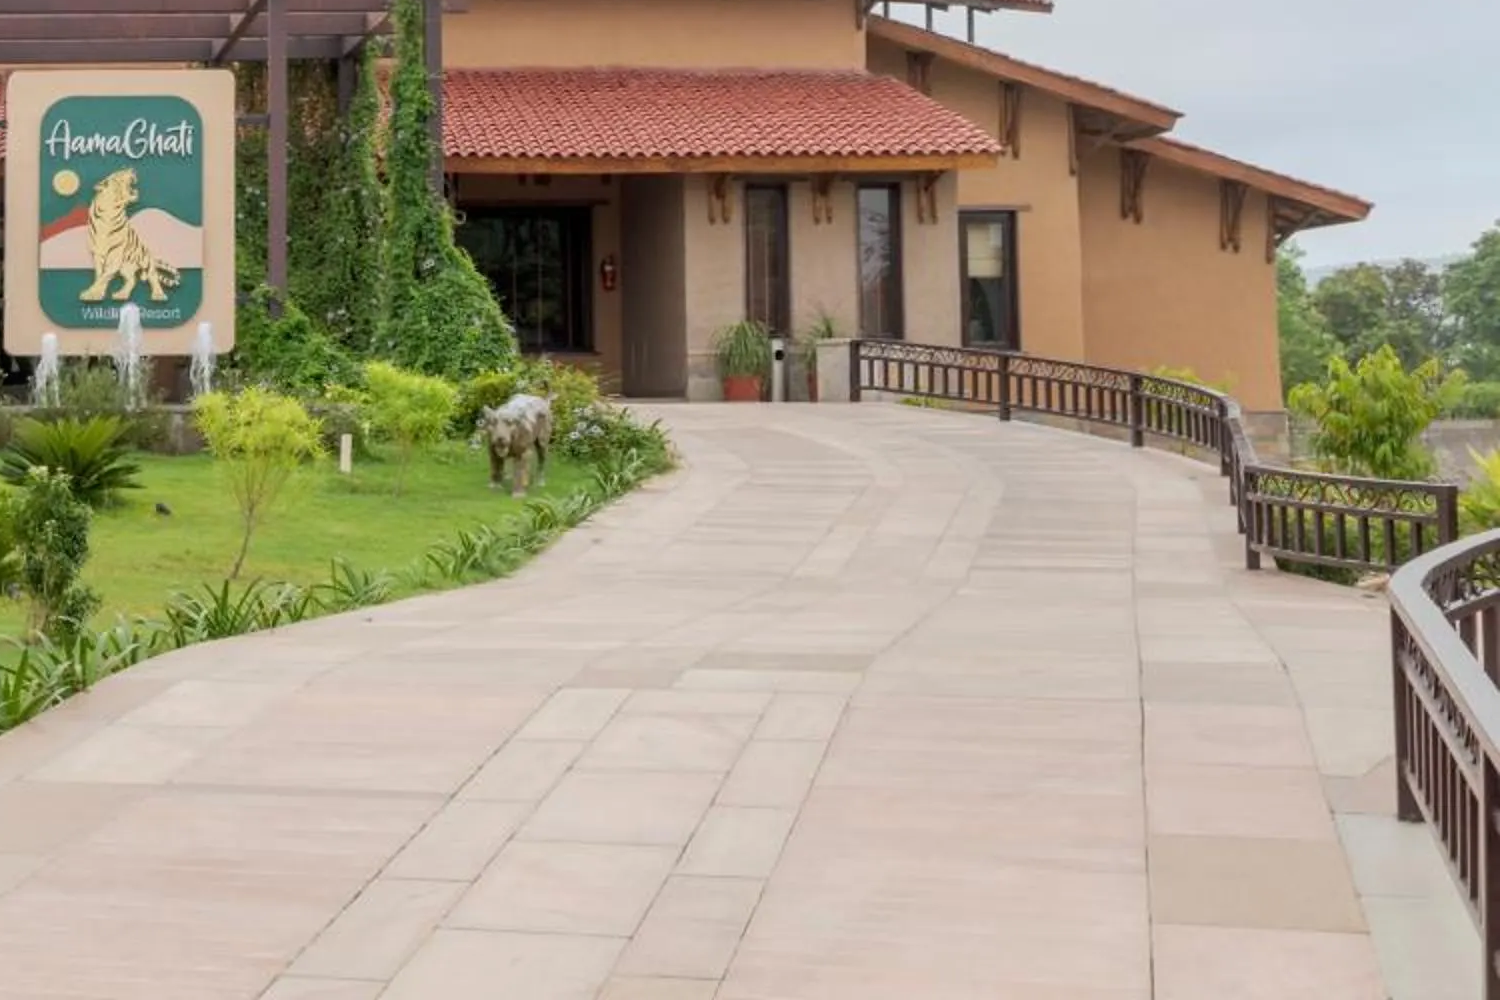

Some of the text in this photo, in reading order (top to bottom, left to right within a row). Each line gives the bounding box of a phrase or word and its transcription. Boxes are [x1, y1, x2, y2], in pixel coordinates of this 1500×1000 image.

[45, 118, 194, 160] AamaGhati
[82, 305, 181, 320] Wildli Resort
